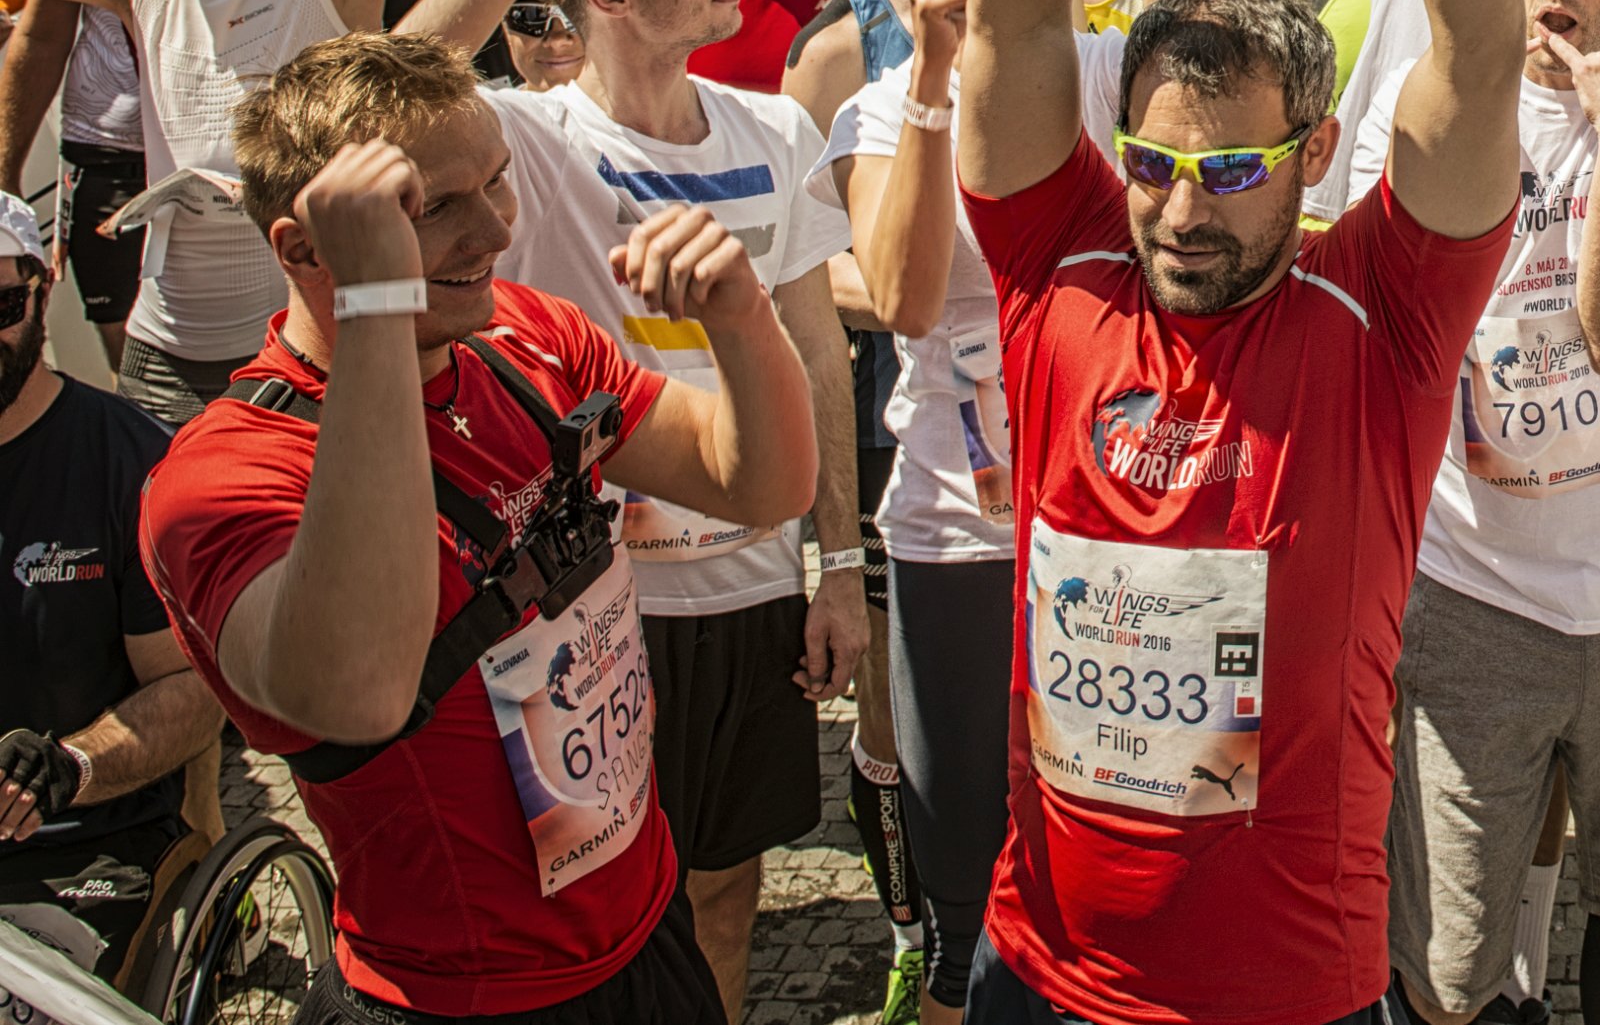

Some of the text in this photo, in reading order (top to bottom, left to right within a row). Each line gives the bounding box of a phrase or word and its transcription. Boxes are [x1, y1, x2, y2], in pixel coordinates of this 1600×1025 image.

[1497, 277, 1553, 296] SLOVENSKO
[958, 341, 988, 358] SLOVAKIA
[1524, 339, 1583, 363] WINGS
[1535, 356, 1568, 376] LIFE
[1570, 364, 1590, 380] 2016
[626, 536, 692, 551] GARMIN
[1088, 605, 1105, 615] FOR
[1094, 587, 1171, 614] WINGS
[574, 601, 619, 654] WINGS
[1102, 610, 1147, 630] LIFE
[587, 632, 612, 668] LIFE
[614, 635, 631, 660] 2016
[1143, 634, 1172, 652] 2016
[493, 647, 531, 677] SLOVAKIA
[1048, 649, 1209, 725] 28333
[562, 651, 649, 781] 67528
[1097, 723, 1148, 761] Filip
[1093, 767, 1188, 795] BFGoodrich
[550, 812, 626, 873] GARMIN
[879, 789, 901, 904] COMPRESSPORT
[57, 886, 118, 897] TOUCH
[82, 879, 114, 891] PRO
